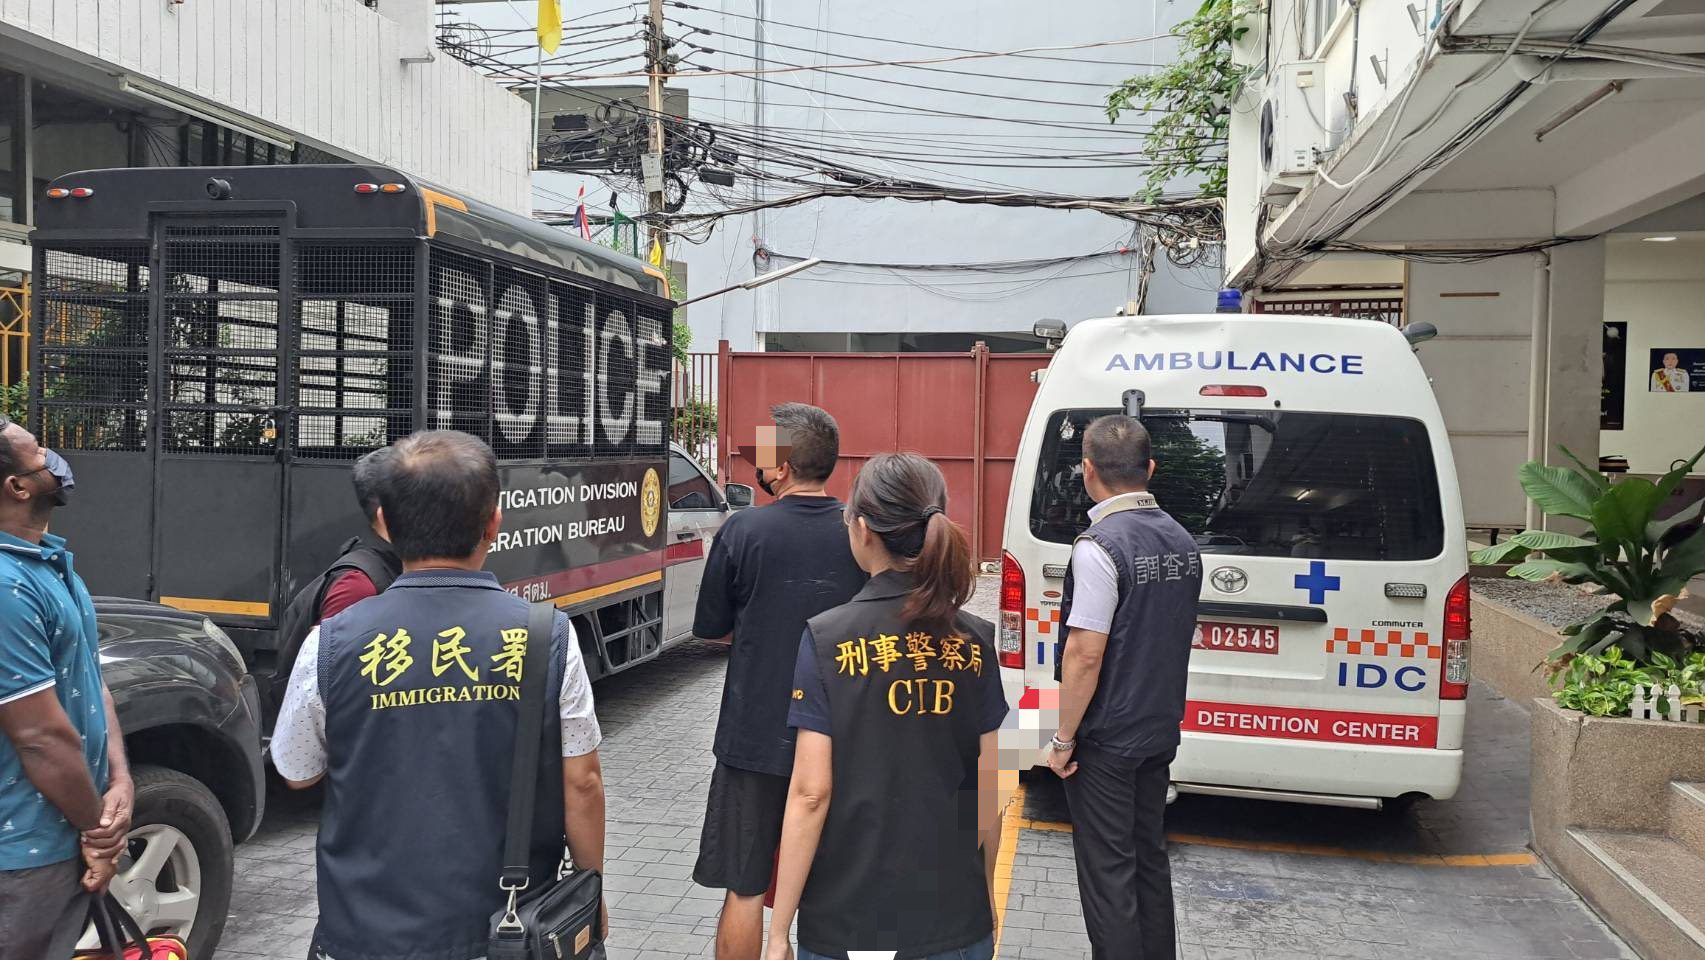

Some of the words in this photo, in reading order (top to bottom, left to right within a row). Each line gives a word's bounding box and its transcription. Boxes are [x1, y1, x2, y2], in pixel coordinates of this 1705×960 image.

[437, 267, 666, 445] POLICE
[1104, 350, 1364, 375] AMBULANCE
[498, 485, 575, 510] TIGATION
[580, 481, 637, 502] DIVISION
[568, 516, 625, 540] BUREAU
[1134, 551, 1200, 585] 調查局
[1211, 626, 1275, 649] 02545
[1372, 620, 1424, 628] COMMUTER
[358, 626, 529, 687] 移民署
[834, 631, 983, 678] 刑事警察局
[1338, 661, 1426, 692] IDC
[370, 684, 521, 710] IMMIGRATION
[887, 678, 956, 715] CIB
[1197, 710, 1319, 734] DETENTION
[1332, 720, 1420, 741] CENTER
